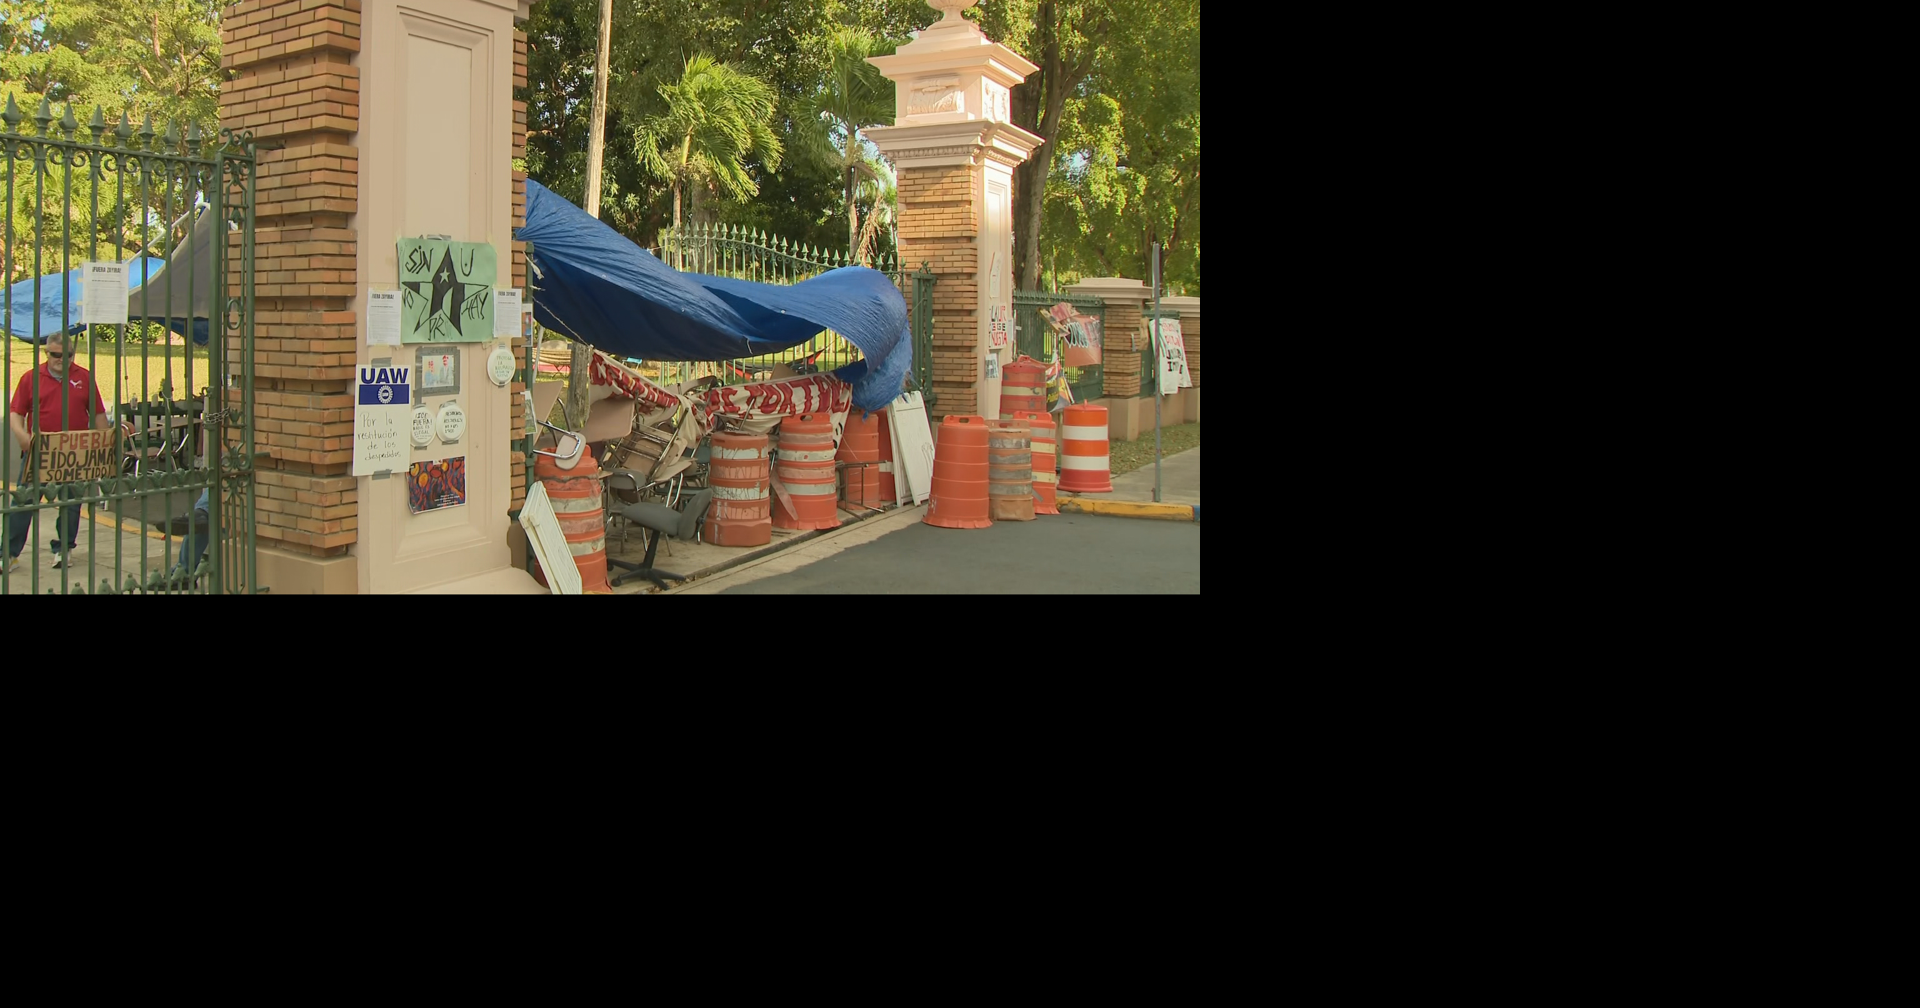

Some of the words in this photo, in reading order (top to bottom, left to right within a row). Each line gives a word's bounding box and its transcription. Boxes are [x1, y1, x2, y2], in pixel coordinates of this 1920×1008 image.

[461, 291, 489, 321] HAY
[361, 368, 408, 384] UAW
[360, 411, 376, 428] Por
[385, 412, 393, 426] la
[357, 428, 398, 441] restitución
[367, 441, 379, 450] de
[38, 447, 76, 470] EÍDO
